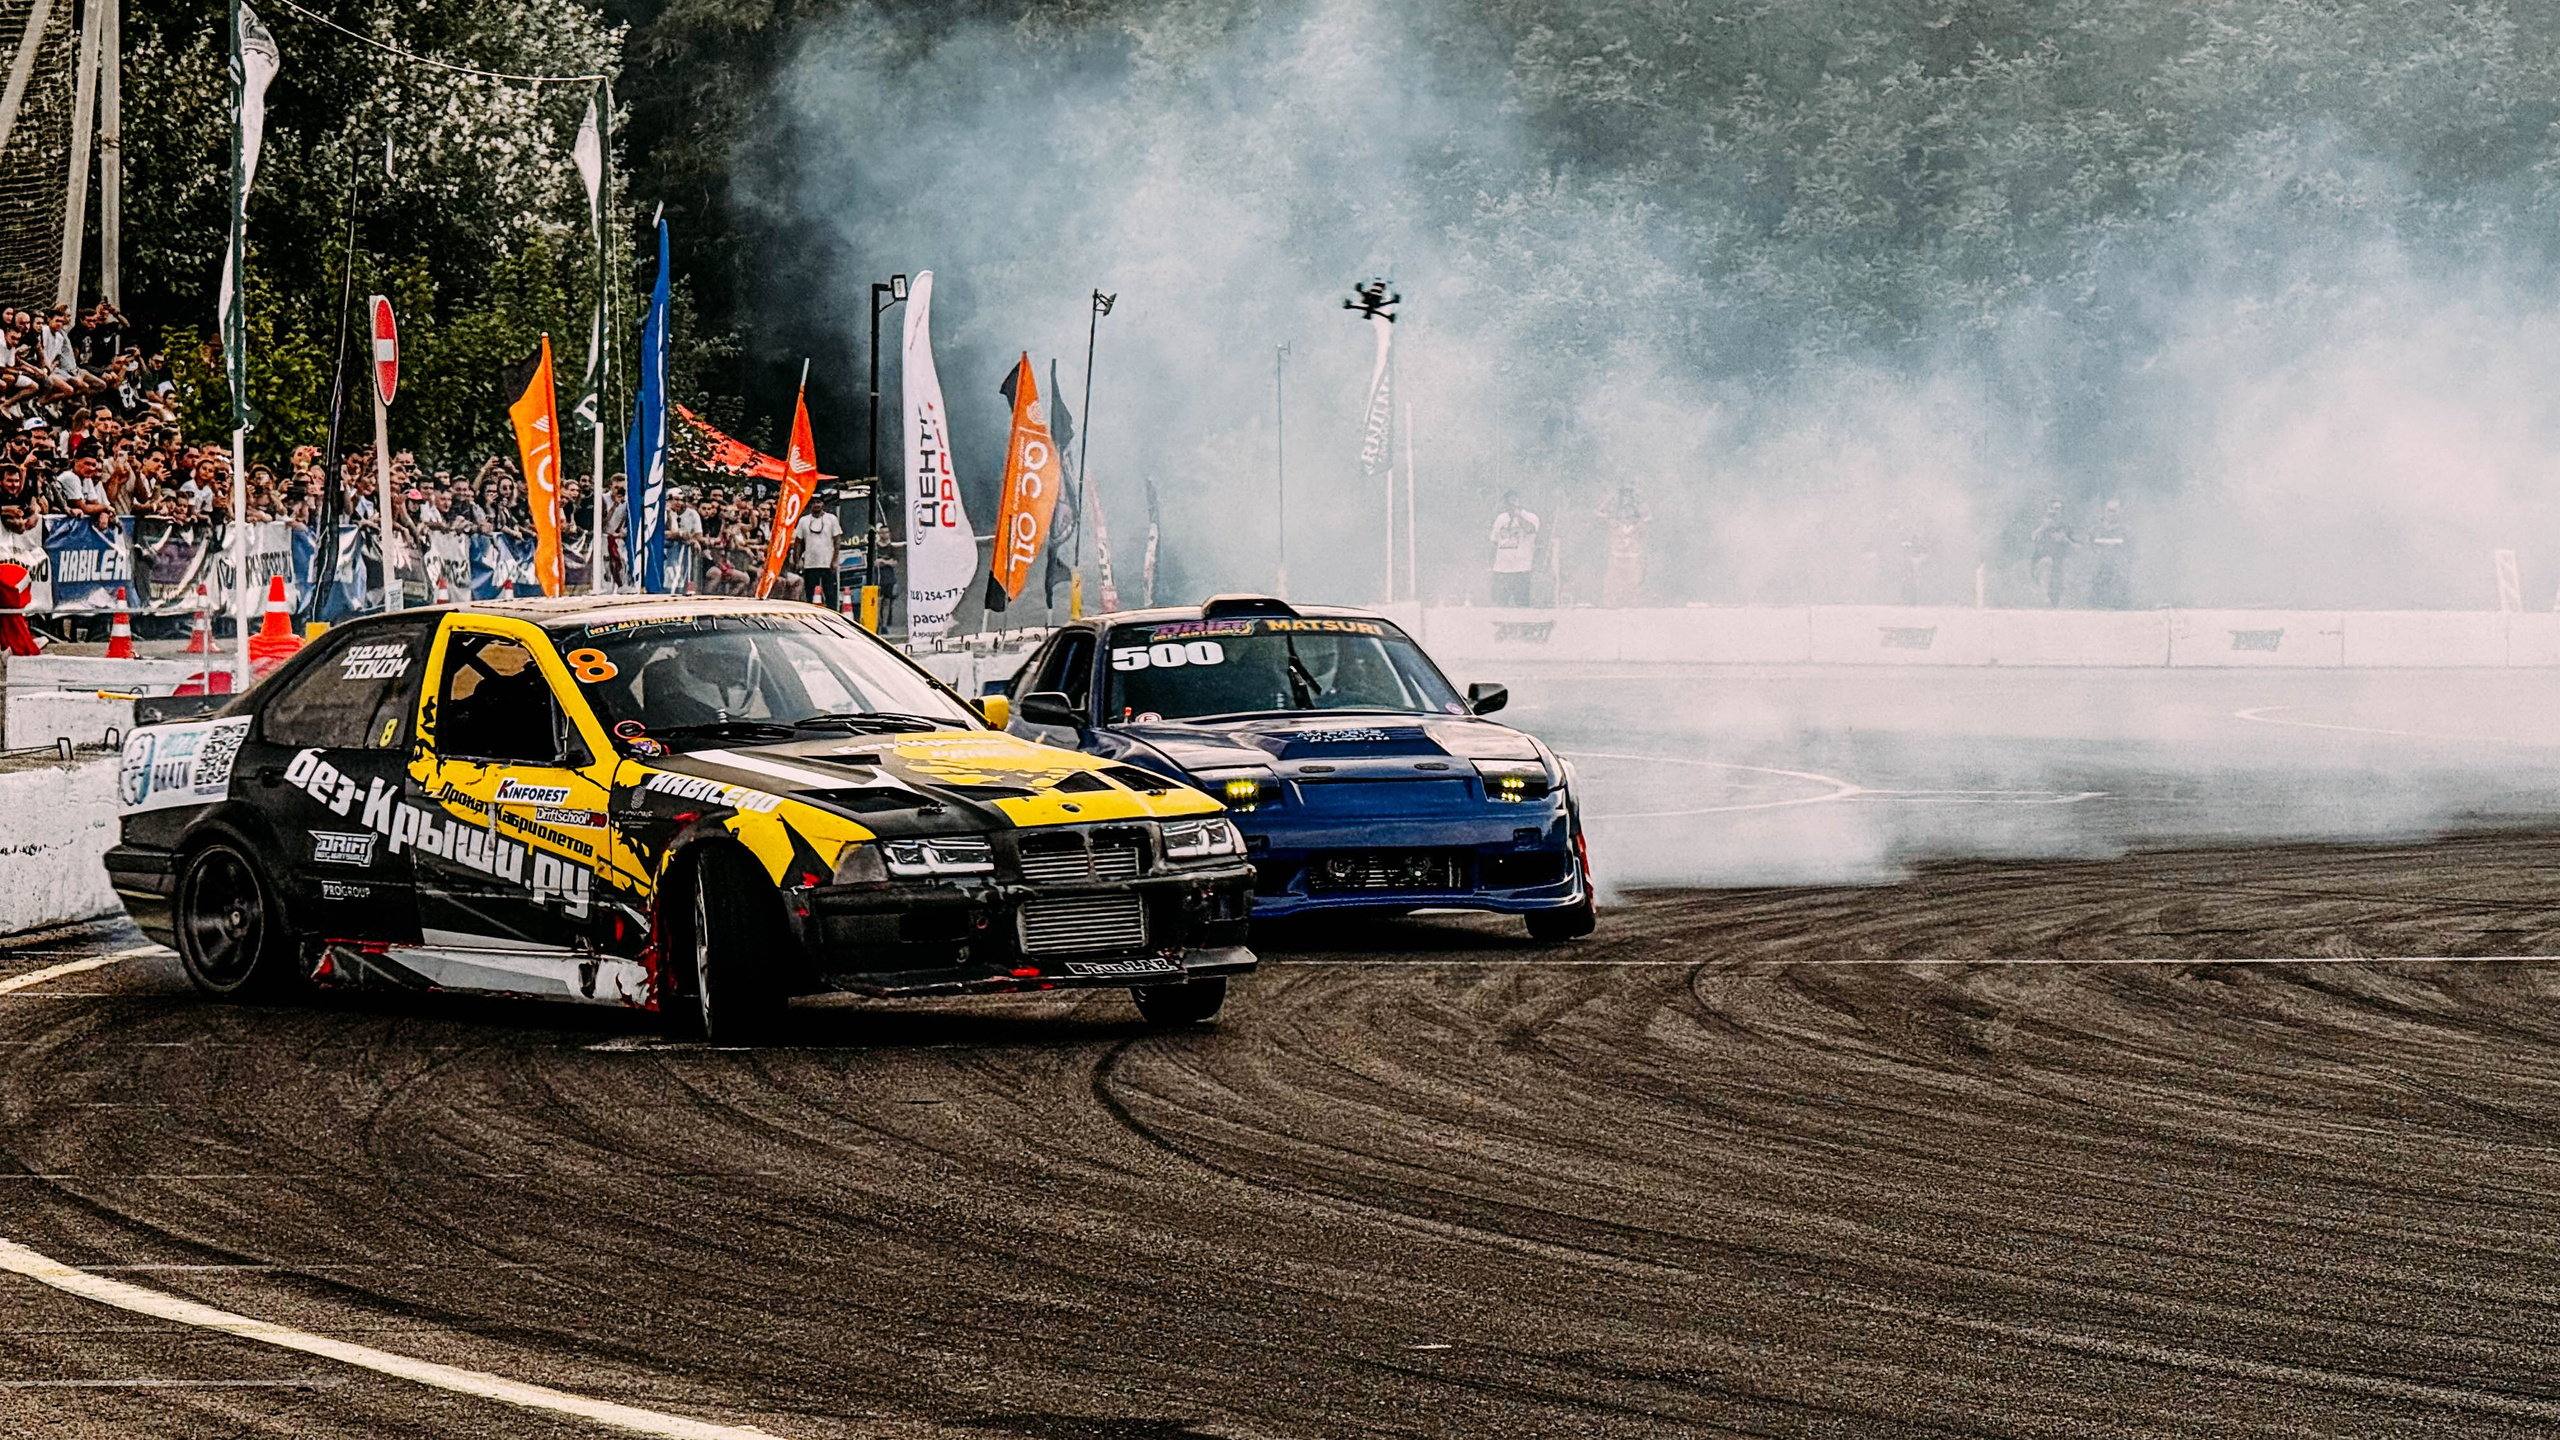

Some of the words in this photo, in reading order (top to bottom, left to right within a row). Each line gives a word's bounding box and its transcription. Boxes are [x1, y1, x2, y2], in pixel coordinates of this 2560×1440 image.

[1021, 440, 1048, 499] QC
[1010, 511, 1038, 572] OIL
[1267, 619, 1384, 636] MATSURI
[567, 648, 618, 683] 8
[1112, 641, 1224, 671] 500
[380, 718, 398, 747] 8
[497, 779, 568, 802] KINFOREST
[646, 773, 784, 813] HABILEAD
